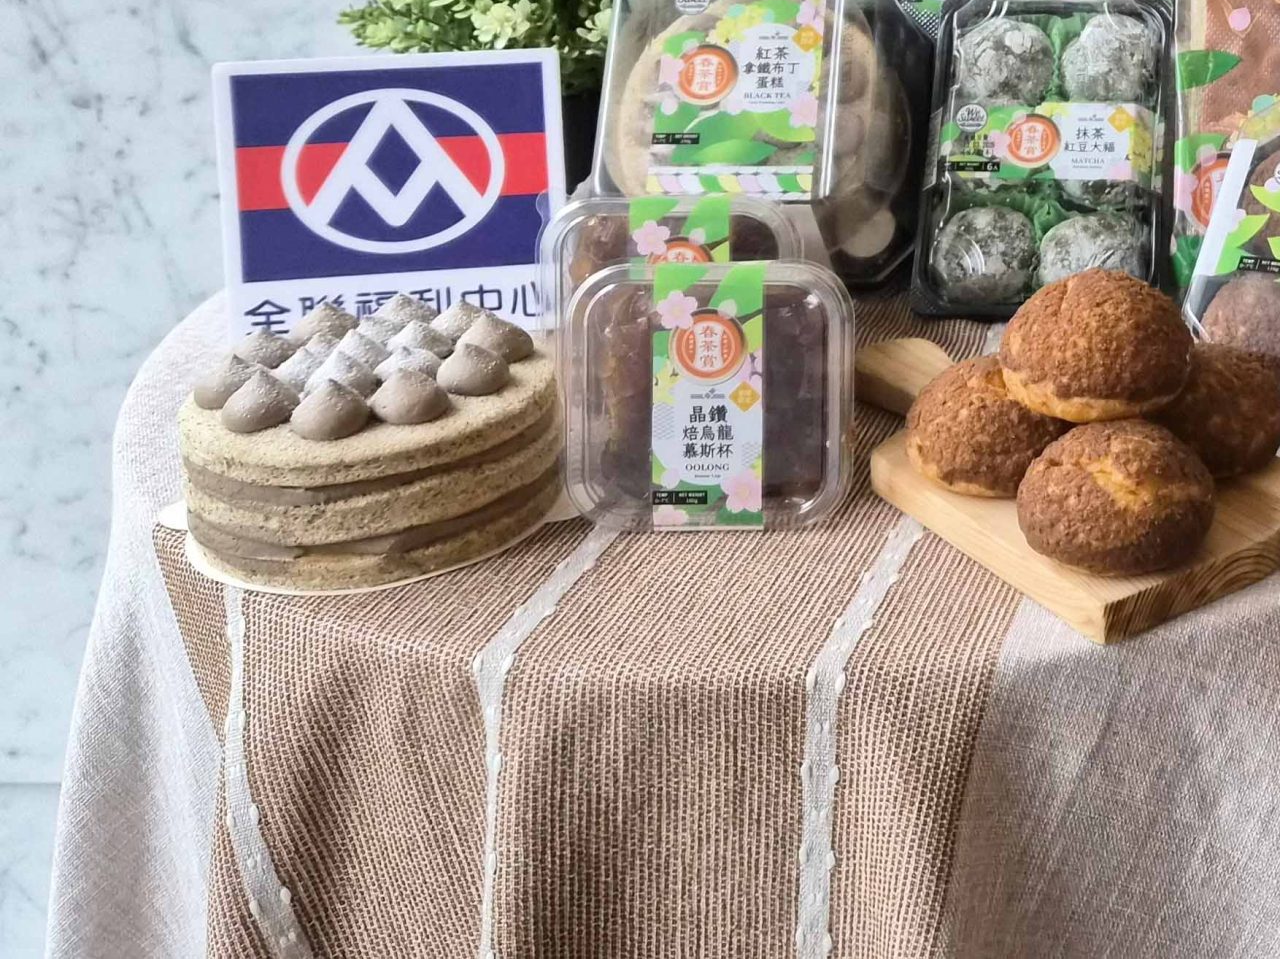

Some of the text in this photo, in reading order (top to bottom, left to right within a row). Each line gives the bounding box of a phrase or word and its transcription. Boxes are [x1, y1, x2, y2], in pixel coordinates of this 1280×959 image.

[755, 46, 790, 61] 紅茶
[743, 62, 800, 75] 拿鐵布丁
[755, 76, 785, 89] 蛋糕
[744, 92, 771, 100] BLACK
[1076, 127, 1106, 139] 抹茶
[1064, 141, 1115, 153] 紅豆大福
[689, 405, 728, 423] 晶鑽
[683, 425, 733, 441] 焙烏龍
[683, 442, 733, 459] 慕斯杯
[685, 463, 730, 472] OOLONG
